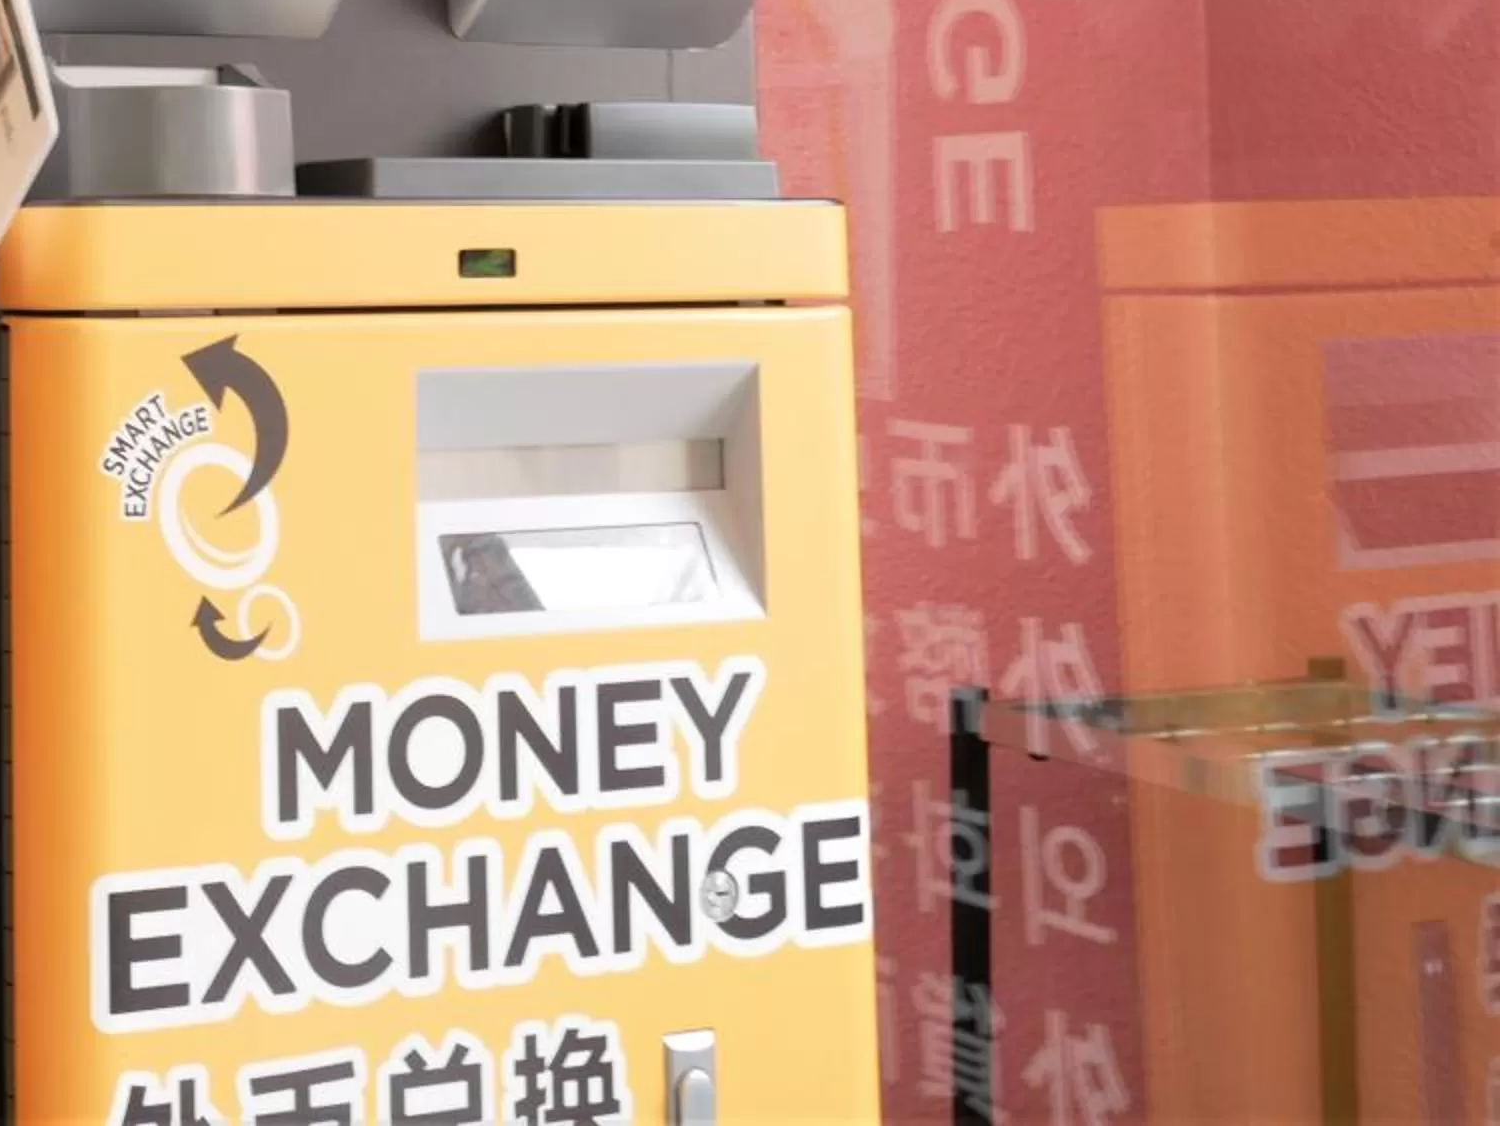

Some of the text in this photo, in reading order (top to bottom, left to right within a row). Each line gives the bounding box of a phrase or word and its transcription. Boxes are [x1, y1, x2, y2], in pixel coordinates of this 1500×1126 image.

[103, 394, 165, 476] SMART
[125, 406, 209, 517] EXCHANGE
[275, 671, 752, 824] MONEY
[107, 814, 865, 1016] EXCHANGE
